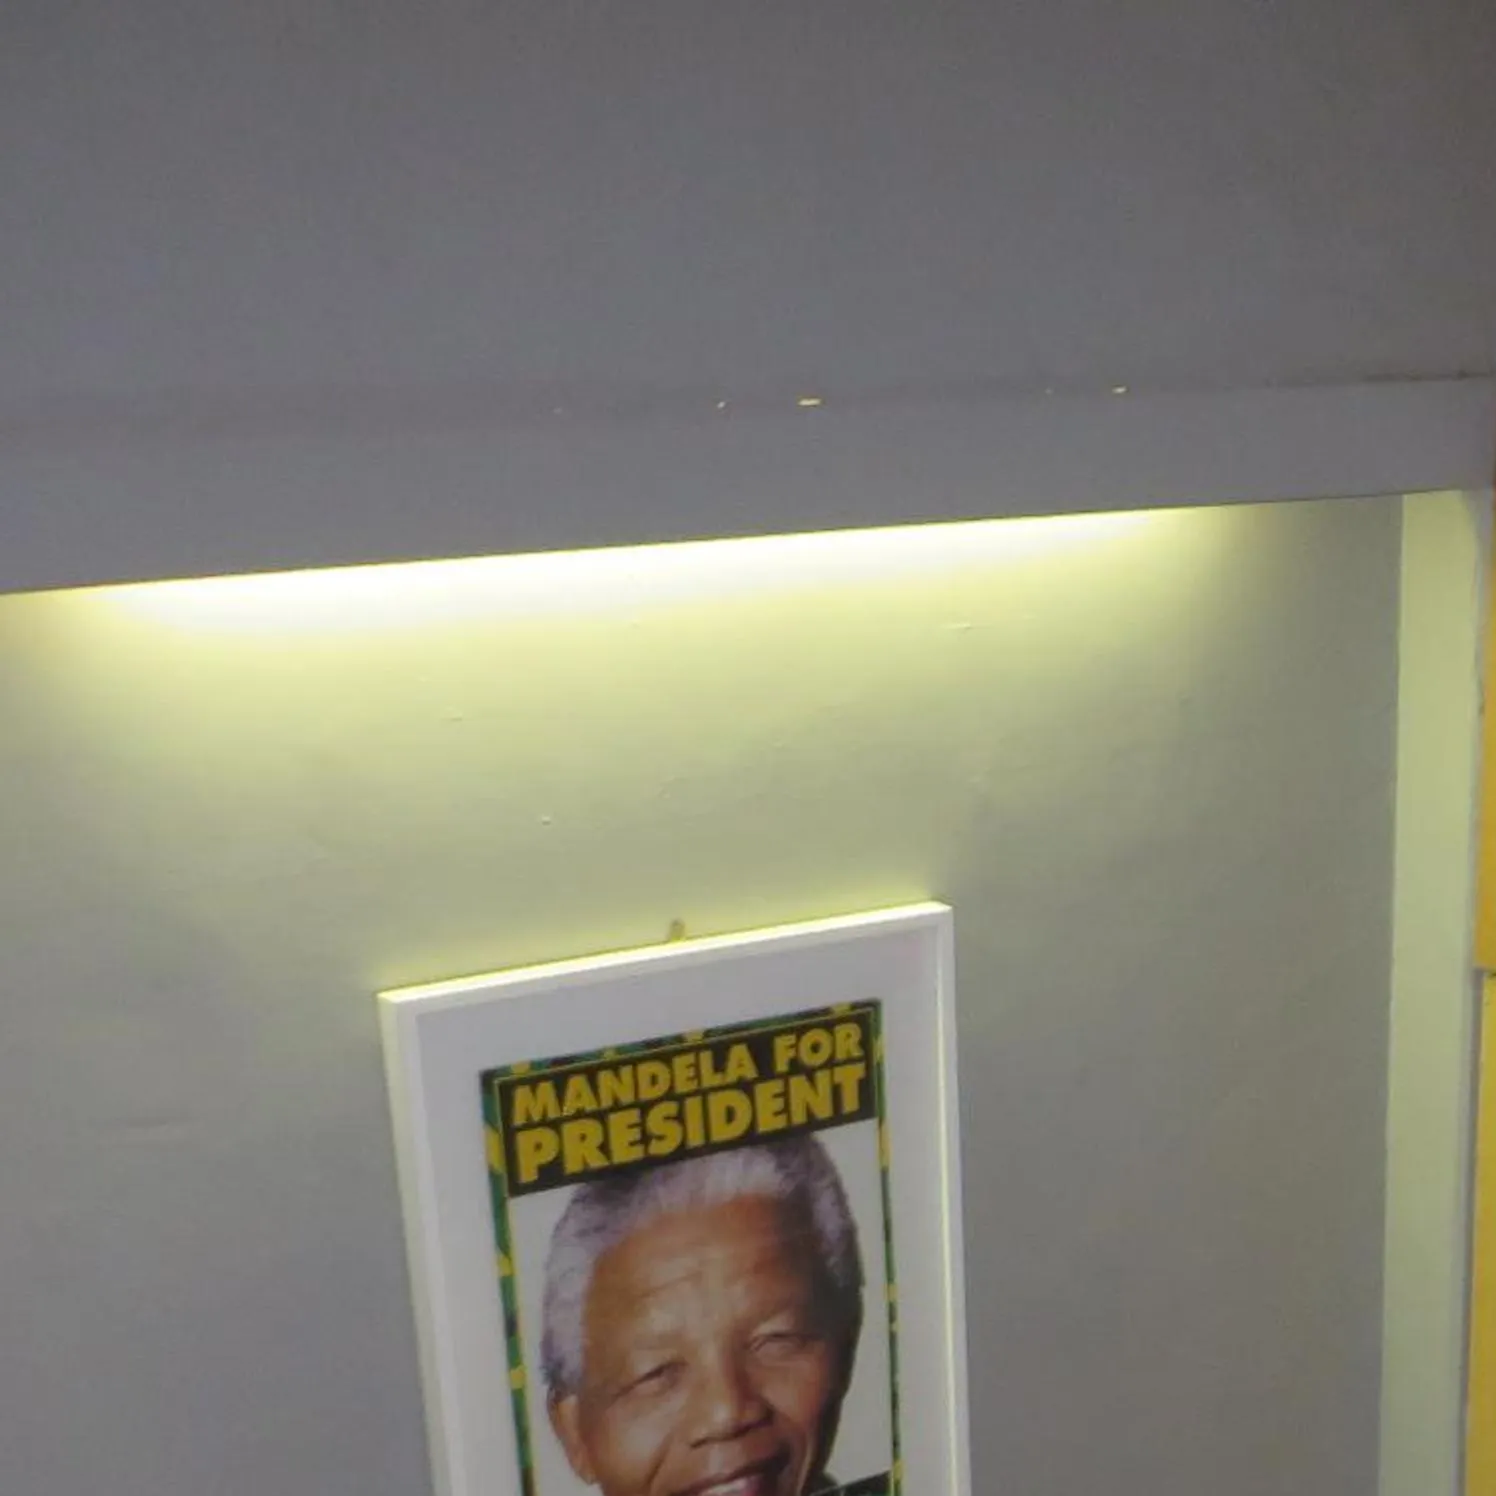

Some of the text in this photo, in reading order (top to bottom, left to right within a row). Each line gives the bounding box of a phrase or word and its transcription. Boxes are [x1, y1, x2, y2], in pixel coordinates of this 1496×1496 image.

[513, 1023, 862, 1126] MANDELA FOR
[515, 1062, 866, 1184] PRESIDENT
